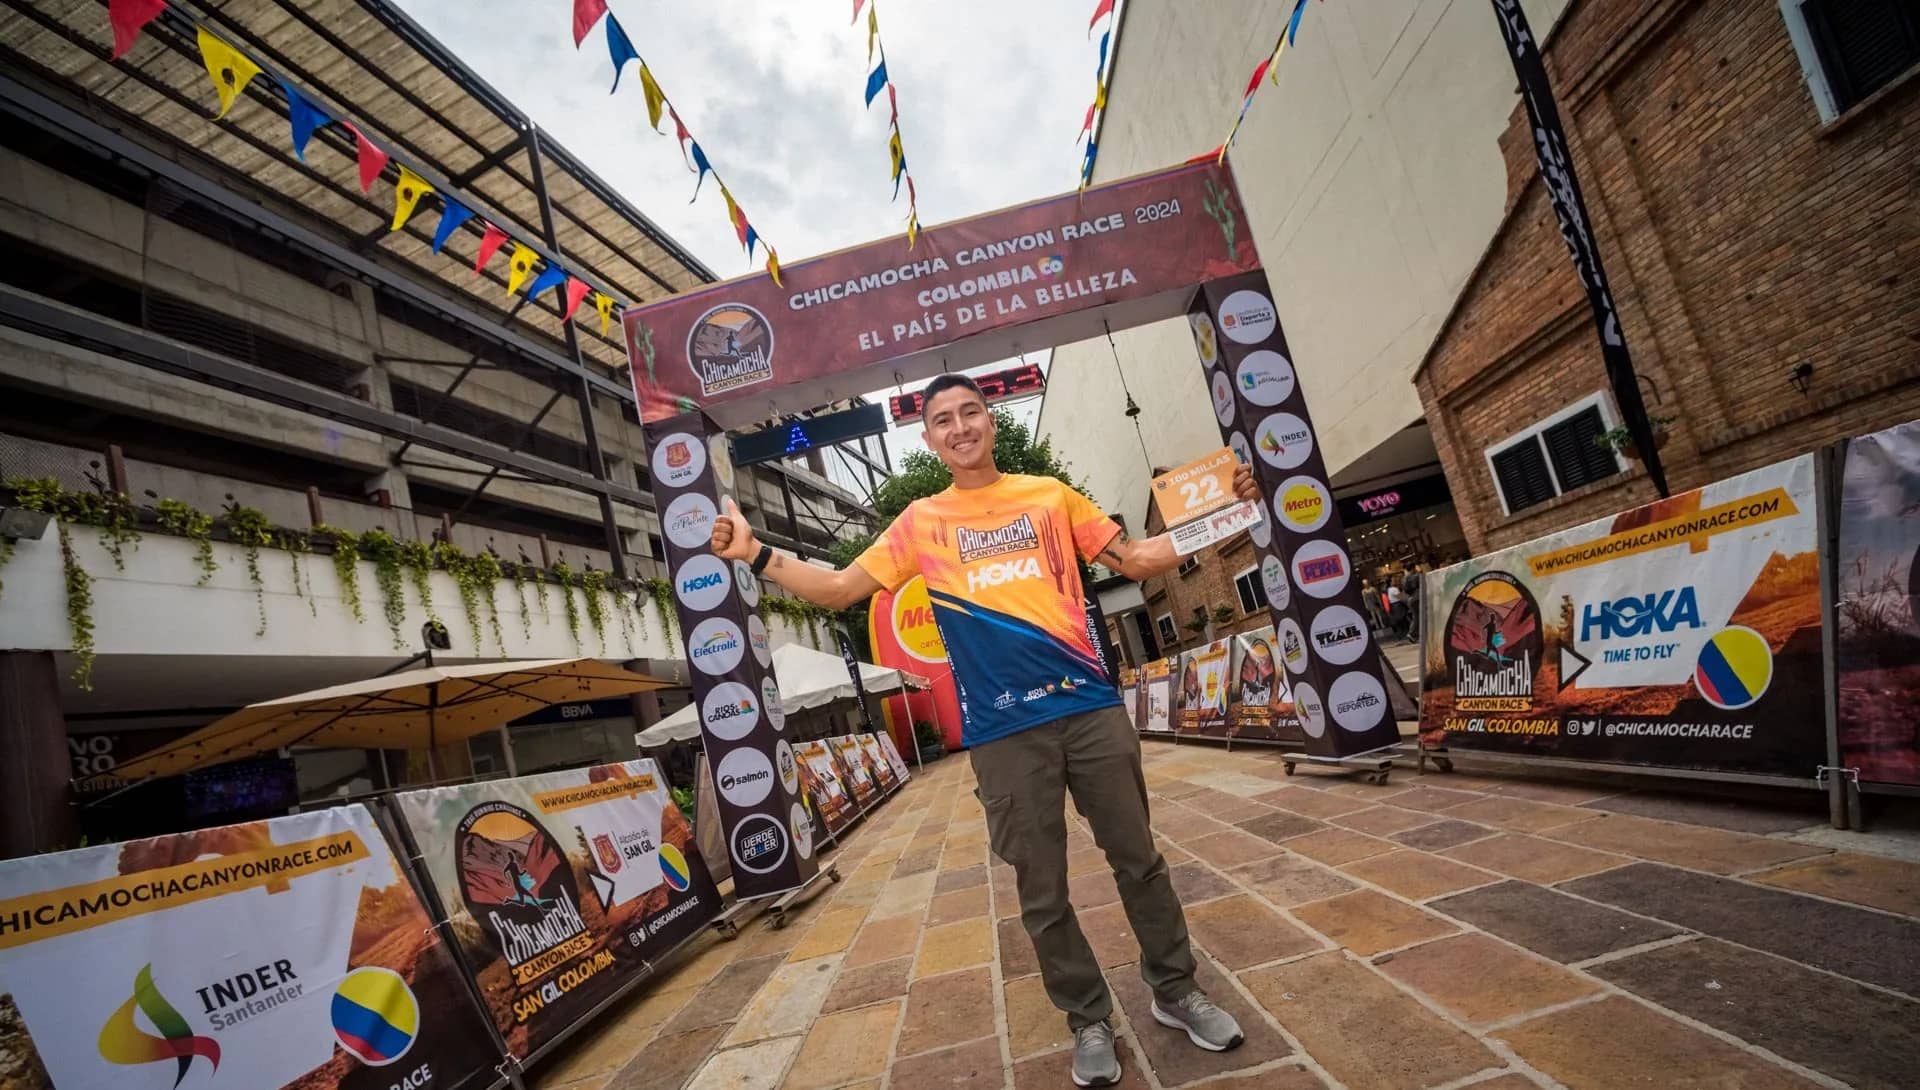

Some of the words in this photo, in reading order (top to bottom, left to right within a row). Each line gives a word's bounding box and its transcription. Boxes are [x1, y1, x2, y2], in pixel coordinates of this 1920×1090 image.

[789, 257, 950, 311] CHICAMOCHA
[955, 230, 1055, 266] CANYON
[1061, 213, 1125, 241] RACE
[1134, 198, 1182, 224] 2024
[917, 265, 1037, 307] COLOMBIA
[858, 330, 885, 351] EL
[892, 312, 947, 342] PAÍS
[956, 302, 987, 325] DE
[996, 293, 1028, 315] LA
[1035, 268, 1138, 306] BELLEZA
[702, 344, 767, 385] CHICAMOCHA
[712, 377, 742, 390] CANYON
[744, 373, 763, 384] RACE
[786, 424, 811, 452] A
[1281, 431, 1307, 442] INDER
[1191, 454, 1231, 476] MILLAS
[1179, 474, 1224, 510] 22
[1285, 497, 1322, 513] Metro
[1358, 492, 1400, 512] YOYO
[957, 513, 1035, 552] CHICAMOCHA
[1535, 498, 1780, 571] WWW.CHICAMOCHACANYONRACE.COM
[970, 546, 1006, 559] CANYON
[1008, 541, 1030, 550] RACE
[683, 572, 723, 594] HOKA
[967, 557, 1042, 593] HOKA
[1581, 586, 1700, 642] HOKA
[693, 639, 738, 659] Electrolit
[1603, 649, 1631, 663] TIME
[1634, 647, 1650, 660] TO
[1456, 650, 1531, 697] CHICAMOCHA
[561, 703, 593, 718] BBVA
[1462, 699, 1498, 710] CANYON
[1500, 699, 1523, 710] RACE
[1444, 718, 1469, 731] SAN
[1468, 718, 1485, 732] GIL
[1487, 719, 1559, 735] COLOMBIA
[1605, 722, 1753, 739] @CHICAMOCHARACE
[736, 770, 768, 785] salmón
[624, 843, 643, 860] SAN
[641, 840, 655, 854] GIL
[489, 884, 586, 966] CHICAMOCHA
[648, 896, 699, 934] @CHICAMOCHARACE
[524, 950, 565, 978] CANYON
[564, 935, 587, 956] RACE
[195, 959, 298, 1014] INDER
[513, 990, 544, 1022] SAN
[541, 981, 563, 1003] GIL
[558, 948, 616, 992] COLOMBIA
[209, 984, 303, 1031] Santander
